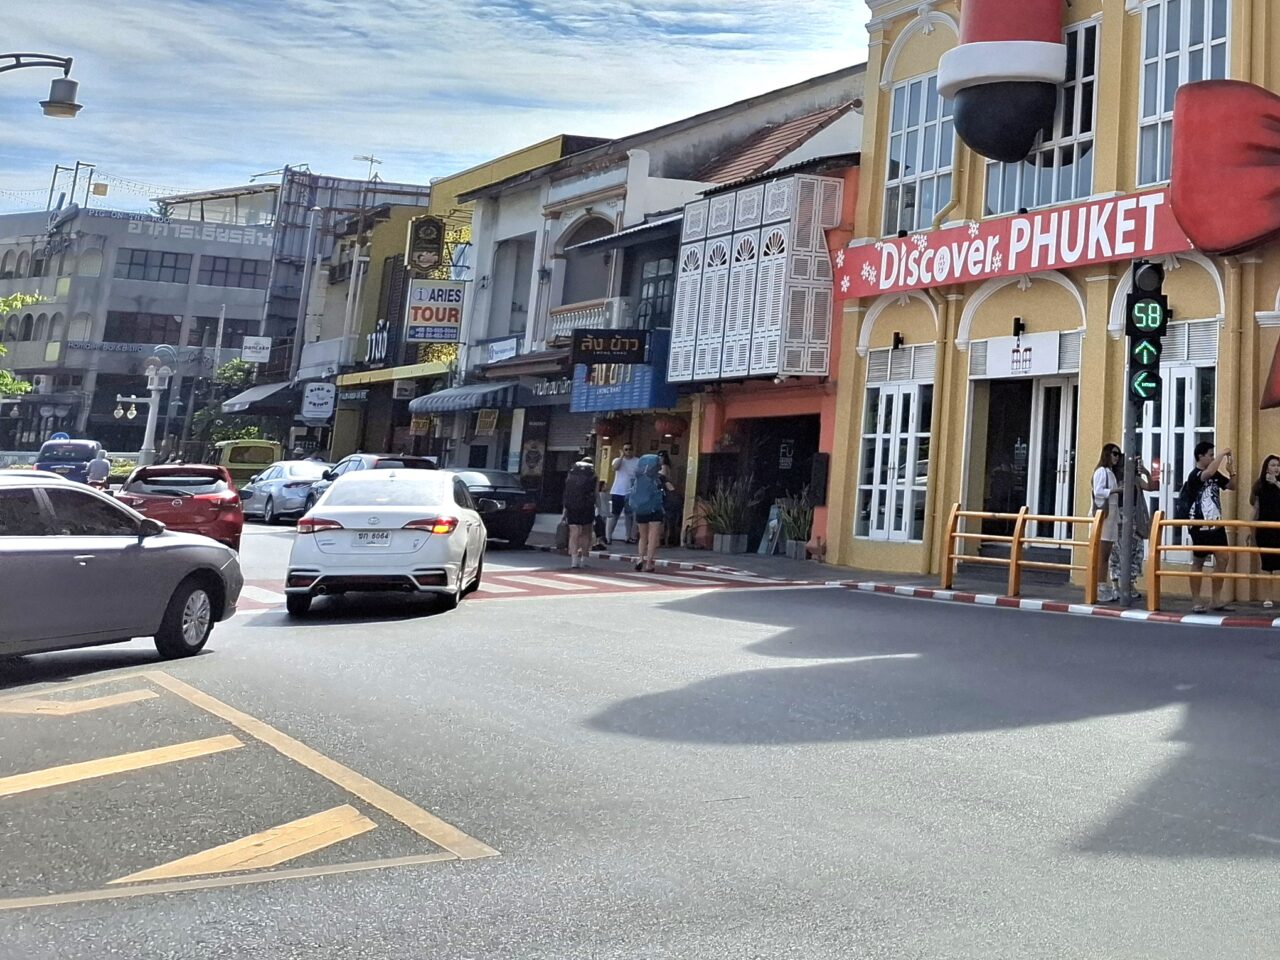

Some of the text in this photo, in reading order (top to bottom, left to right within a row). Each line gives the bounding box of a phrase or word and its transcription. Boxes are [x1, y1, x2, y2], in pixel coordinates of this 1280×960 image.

[88, 209, 105, 217] PIG
[111, 211, 124, 219] ON
[128, 213, 145, 221] THE
[879, 192, 1165, 290] Discover PHUKET
[428, 288, 462, 303] ARIES
[411, 305, 459, 323] TOUR
[1133, 302, 1162, 329] 58
